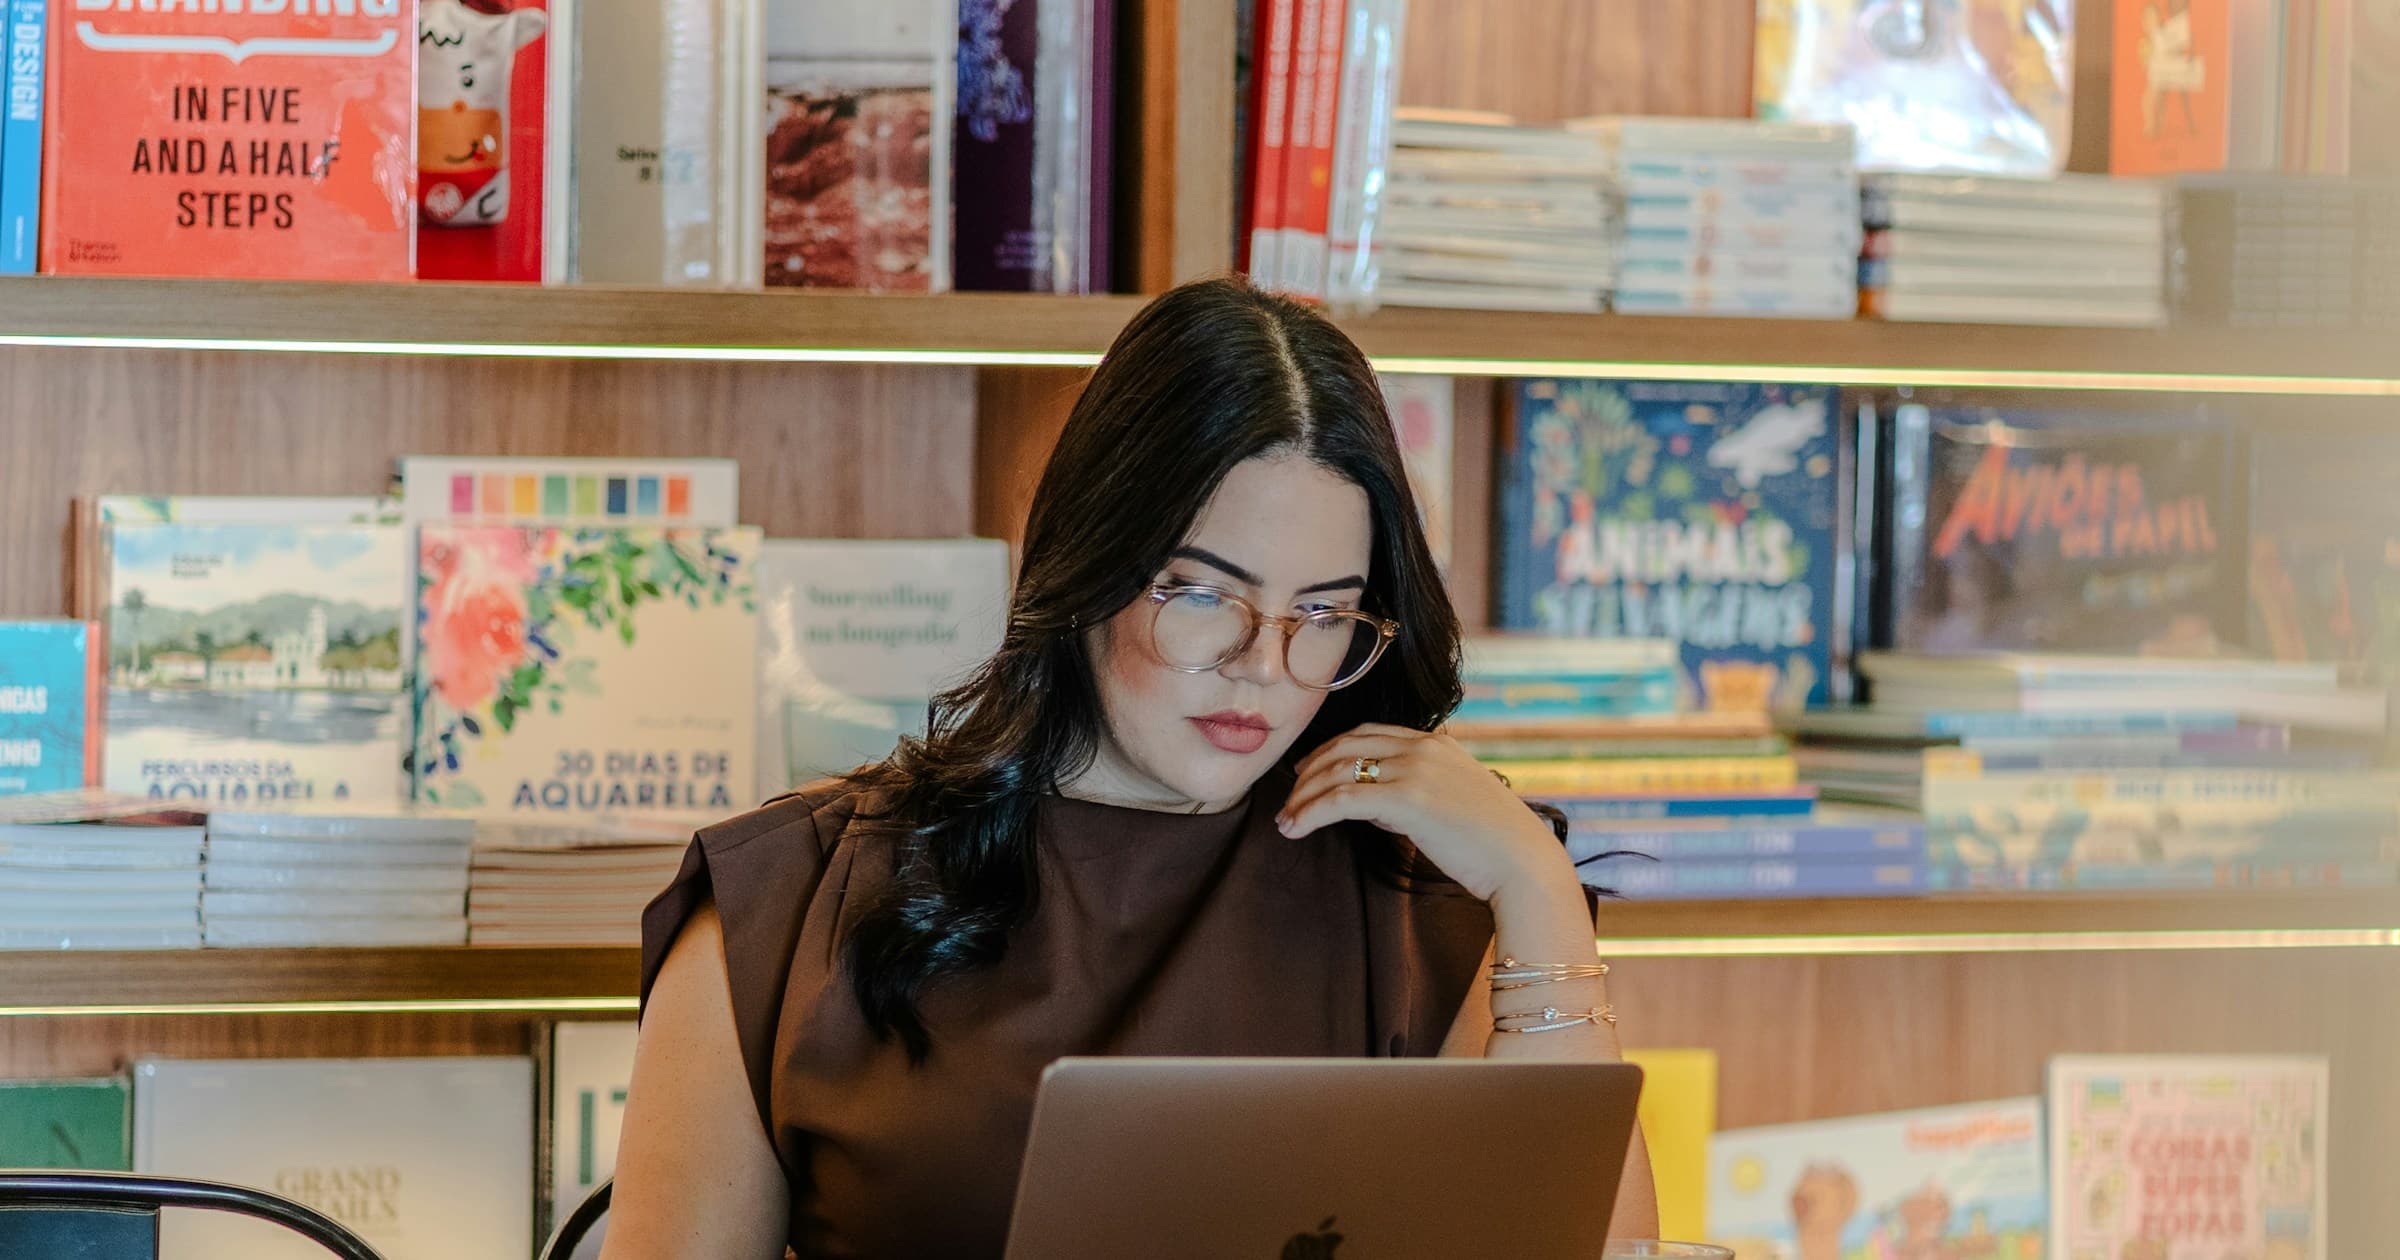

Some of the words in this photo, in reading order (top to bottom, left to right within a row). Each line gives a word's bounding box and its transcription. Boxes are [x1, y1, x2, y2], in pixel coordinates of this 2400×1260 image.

[11, 23, 41, 120] DESIGN
[172, 86, 208, 121] IN
[222, 87, 300, 123] FIVE
[132, 138, 206, 174] AND
[218, 140, 238, 174] A
[250, 141, 340, 177] HALF
[177, 190, 294, 229] STEPS
[557, 750, 594, 776] 30
[605, 750, 679, 776] DIAS
[692, 750, 728, 776] DE
[513, 781, 731, 810] AQUARELA
[276, 1166, 401, 1194] GRAND
